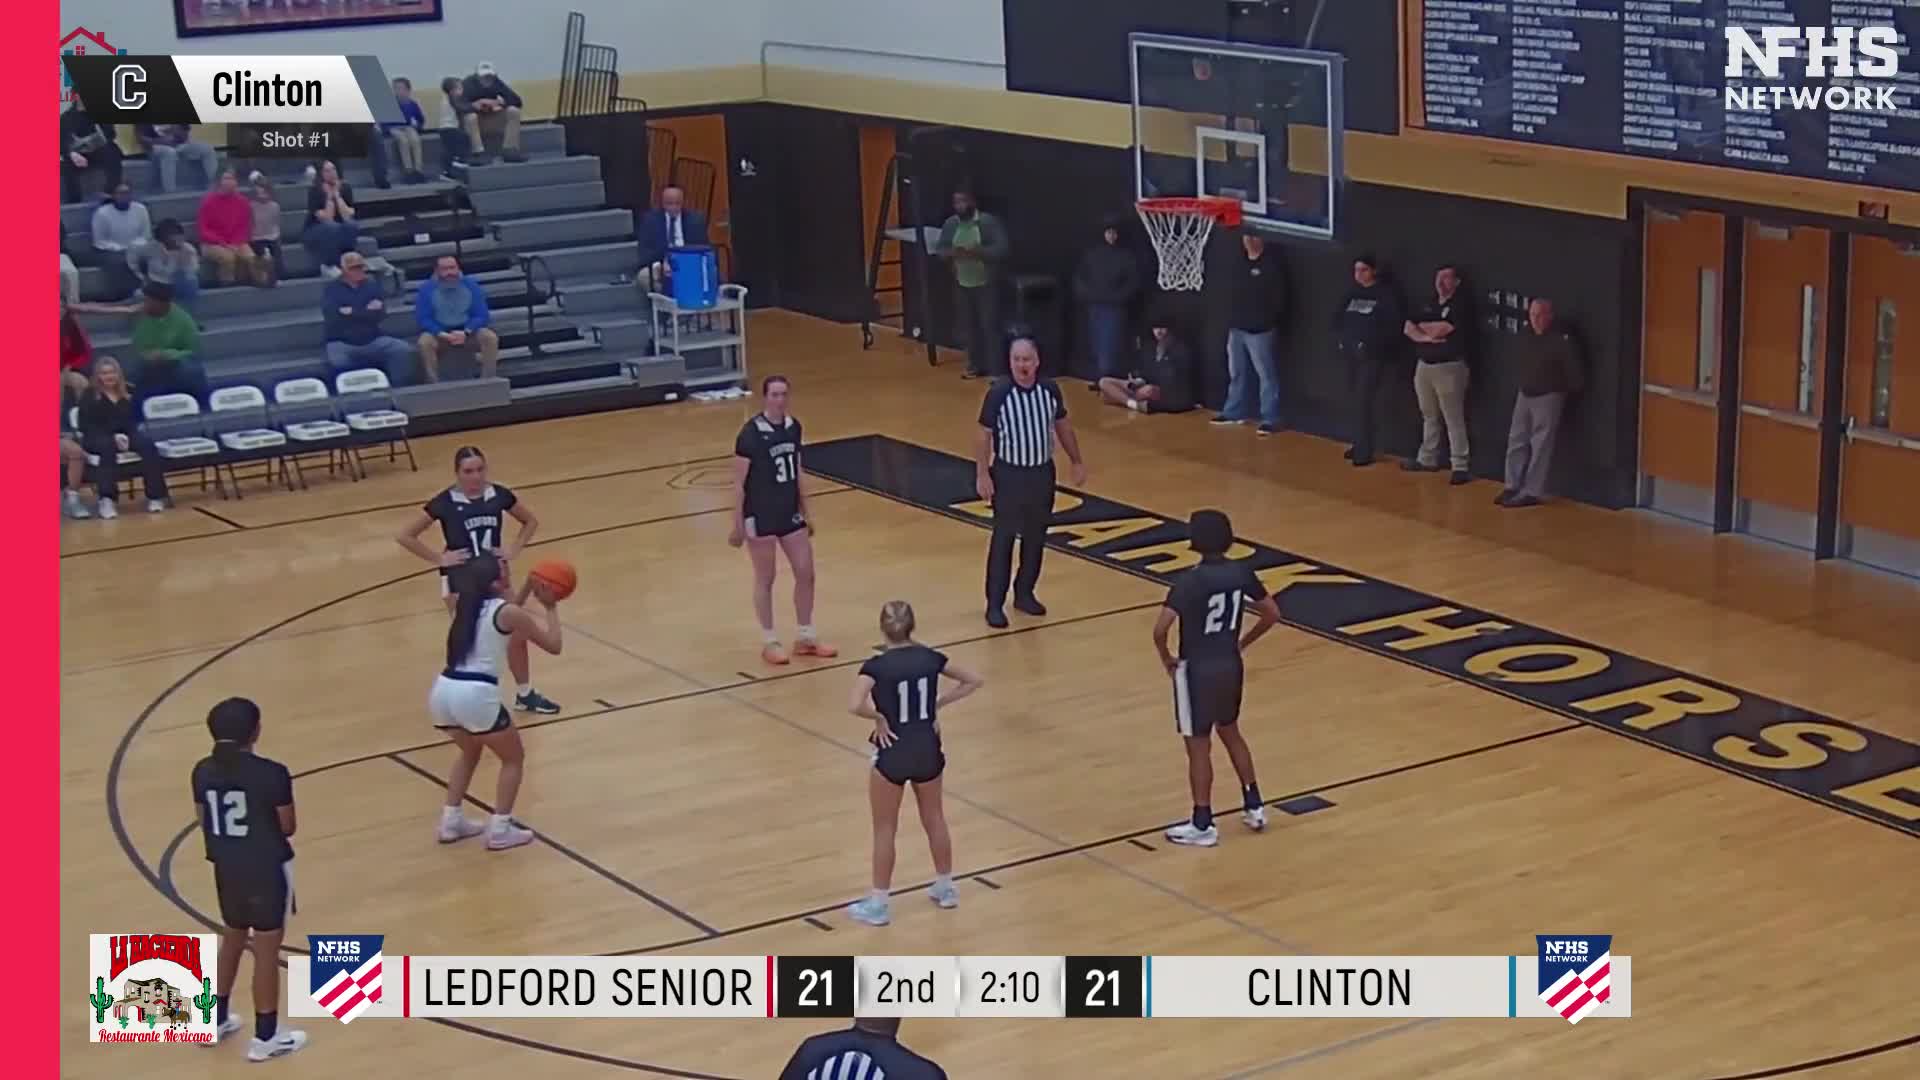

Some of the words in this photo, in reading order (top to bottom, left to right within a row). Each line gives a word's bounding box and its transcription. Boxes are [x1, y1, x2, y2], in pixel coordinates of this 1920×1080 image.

[774, 453, 796, 483] 31
[469, 528, 493, 557] 14
[1204, 589, 1241, 635] 21
[897, 676, 929, 723] 11
[205, 789, 249, 836] 12
